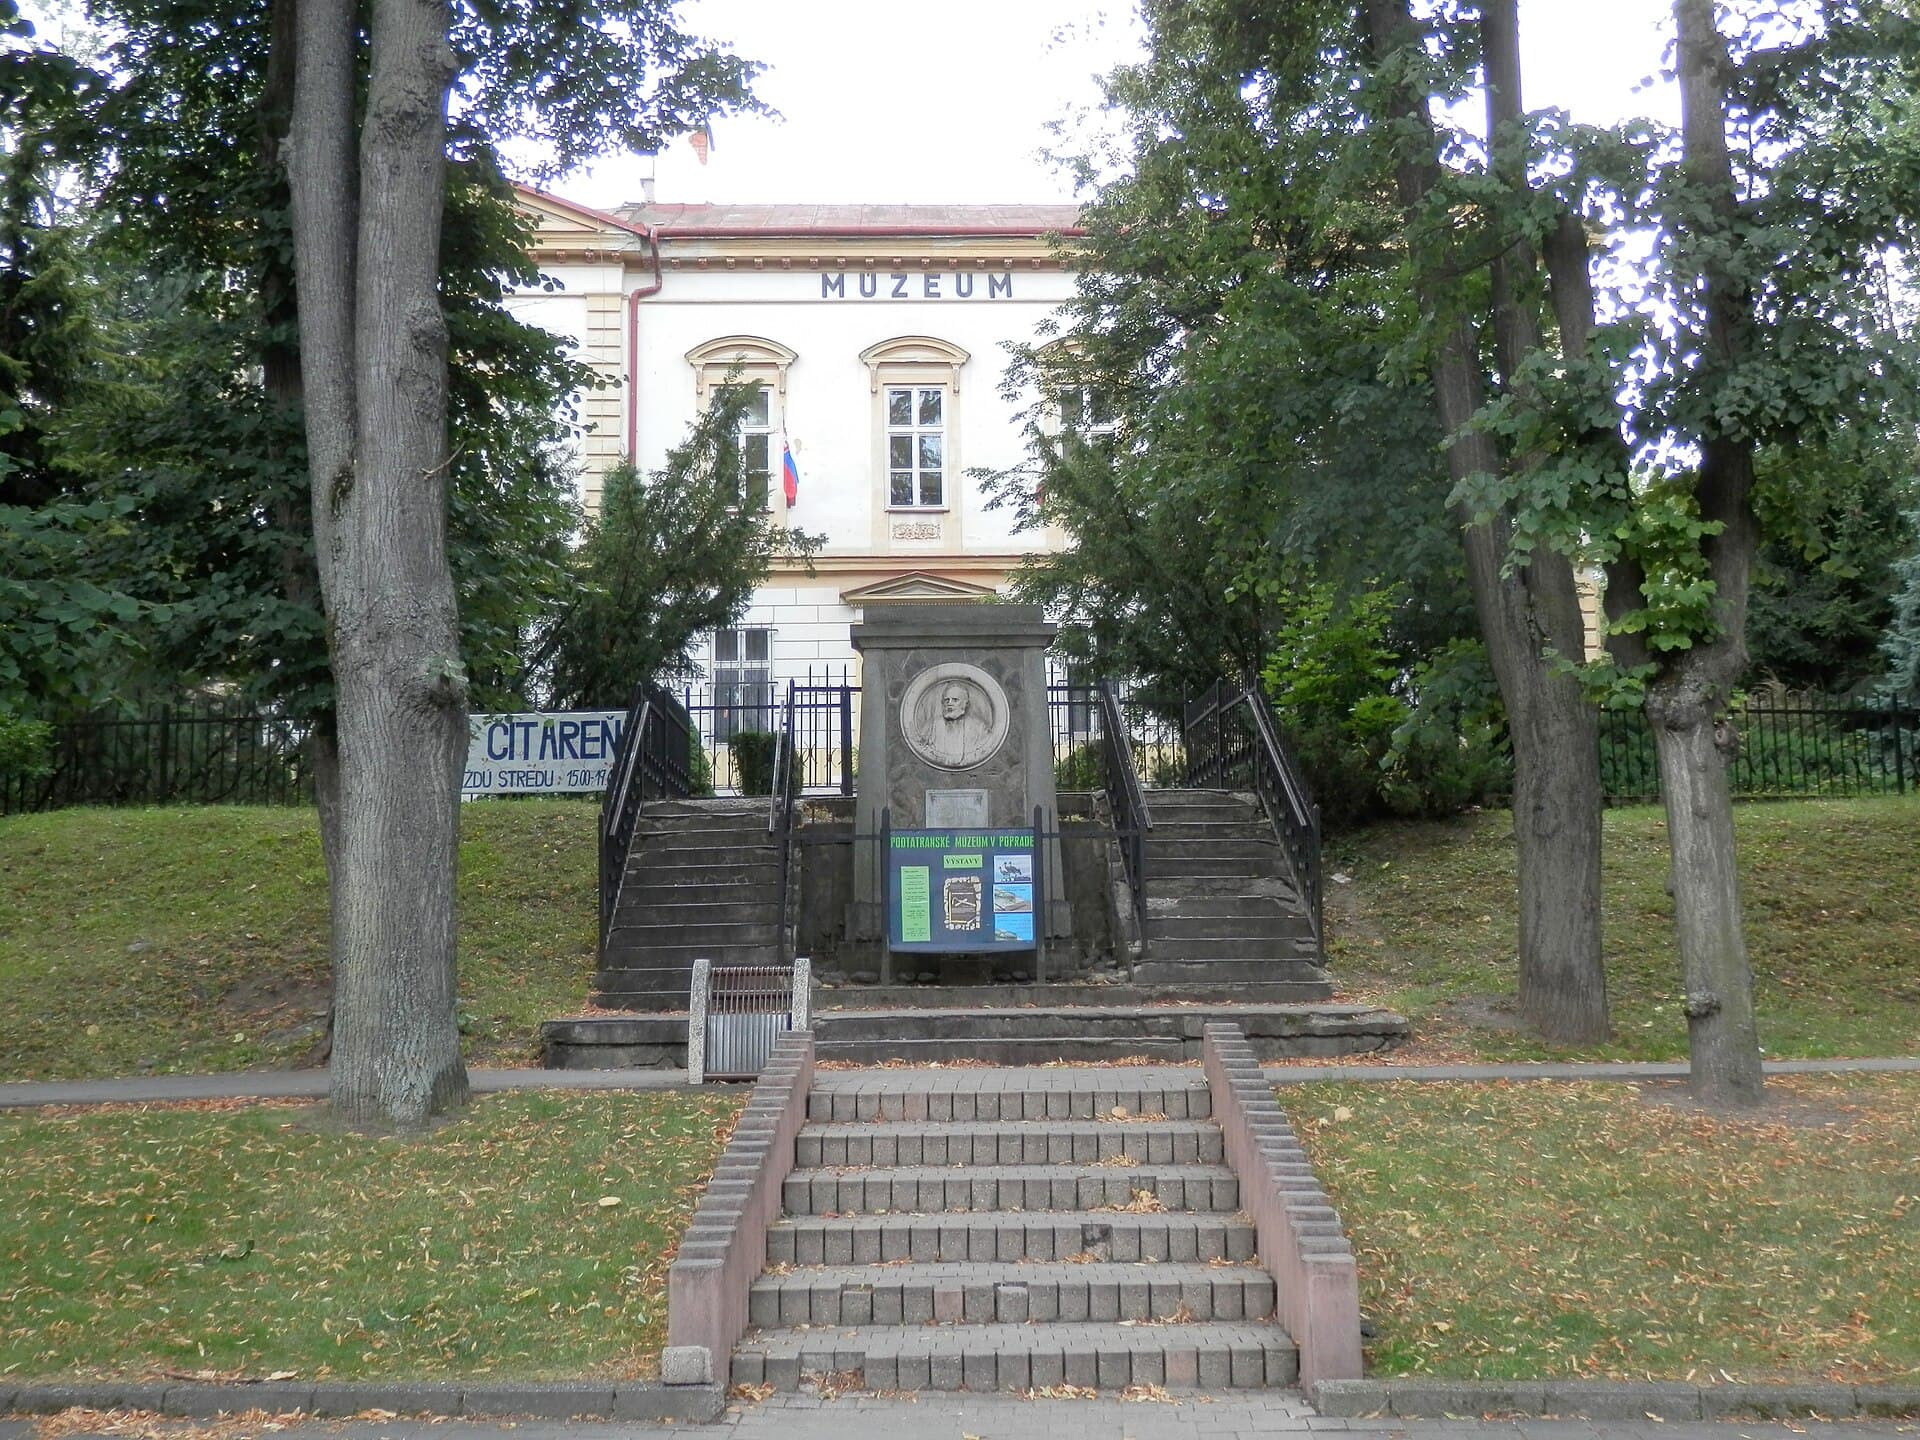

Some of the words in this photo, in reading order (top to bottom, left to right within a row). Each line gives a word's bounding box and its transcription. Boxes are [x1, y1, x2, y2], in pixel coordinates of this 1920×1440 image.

[498, 770, 554, 788] STREDU
[890, 834, 950, 848] PODTATRANSKÉ
[990, 835, 996, 848] V
[999, 835, 1034, 848] POPRADE
[945, 856, 979, 865] VÝSTAVY
